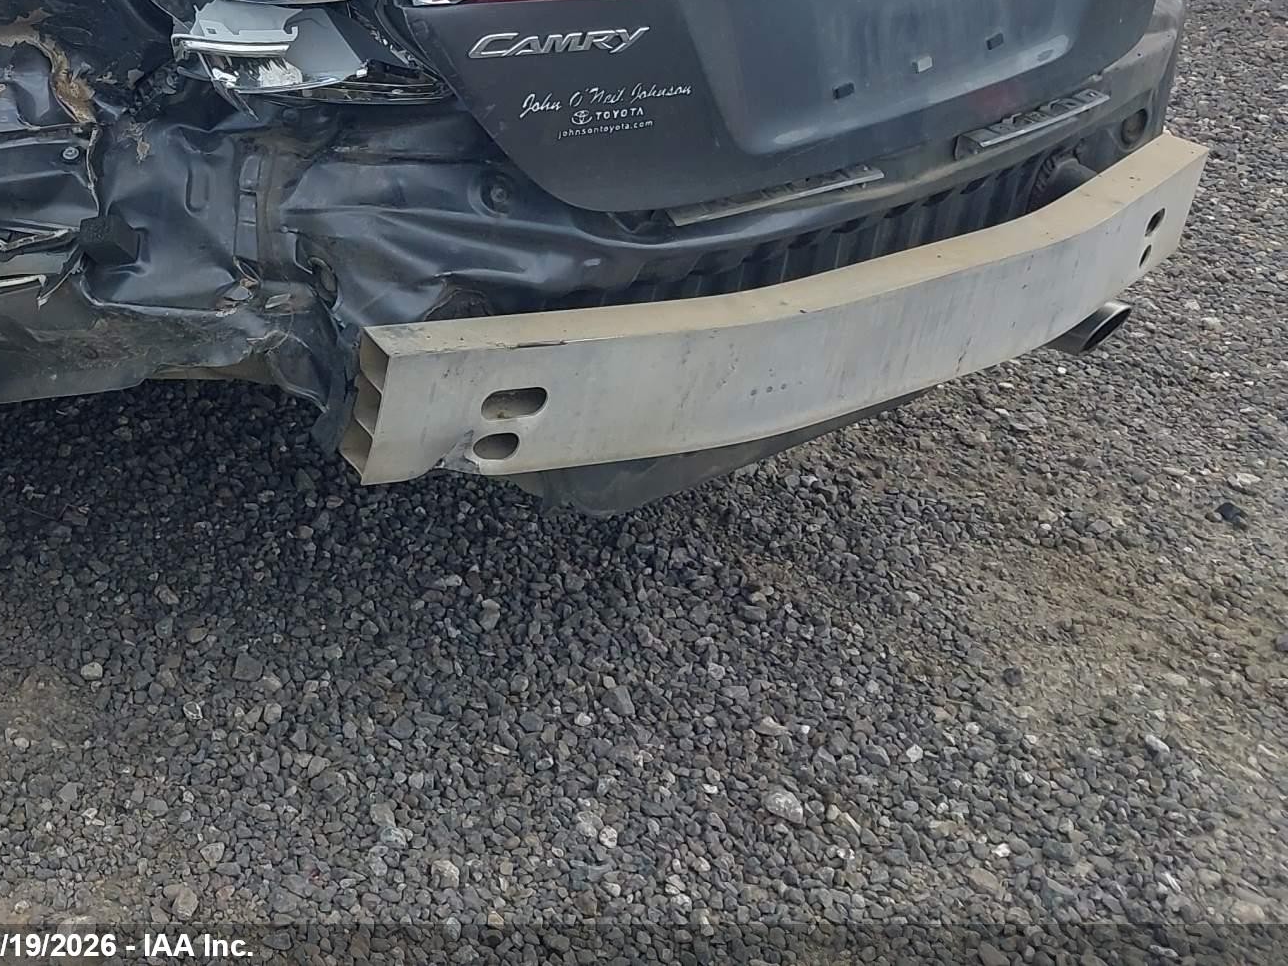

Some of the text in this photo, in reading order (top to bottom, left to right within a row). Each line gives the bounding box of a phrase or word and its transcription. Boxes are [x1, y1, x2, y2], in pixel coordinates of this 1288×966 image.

[468, 26, 650, 59] CAMRY
[519, 92, 562, 118] John
[631, 82, 691, 104] Johnson
[595, 106, 644, 121] TOYOTA
[558, 119, 654, 140] johnsontoyota.com
